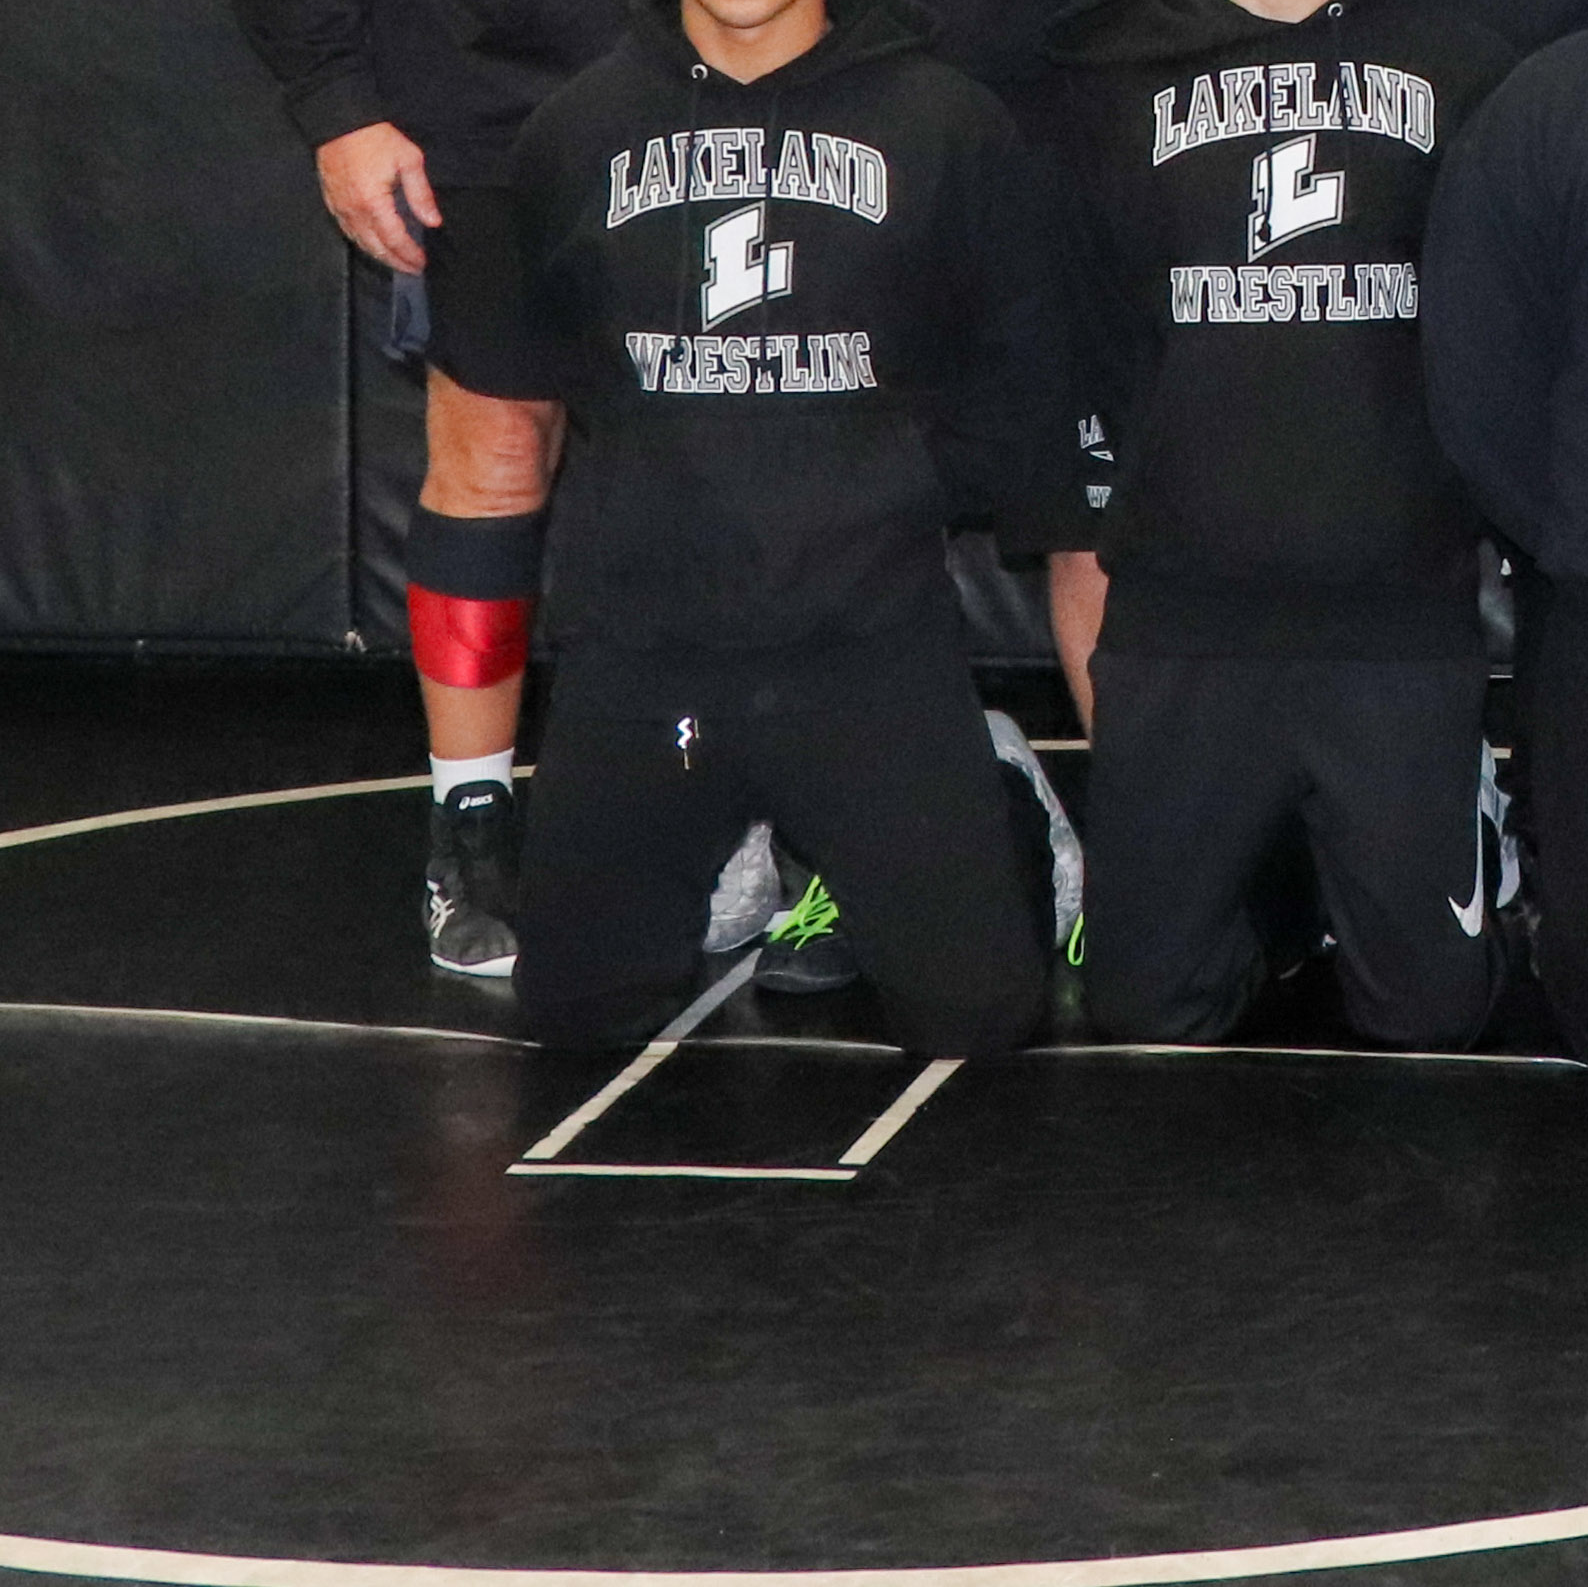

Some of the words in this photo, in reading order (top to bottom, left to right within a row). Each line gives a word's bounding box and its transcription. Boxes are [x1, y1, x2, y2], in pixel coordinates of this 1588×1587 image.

[1153, 62, 1434, 165] LAKELAND
[606, 128, 888, 229] LAKELAND
[1170, 262, 1420, 324] WRESTLING
[626, 331, 877, 394] WRESTLING
